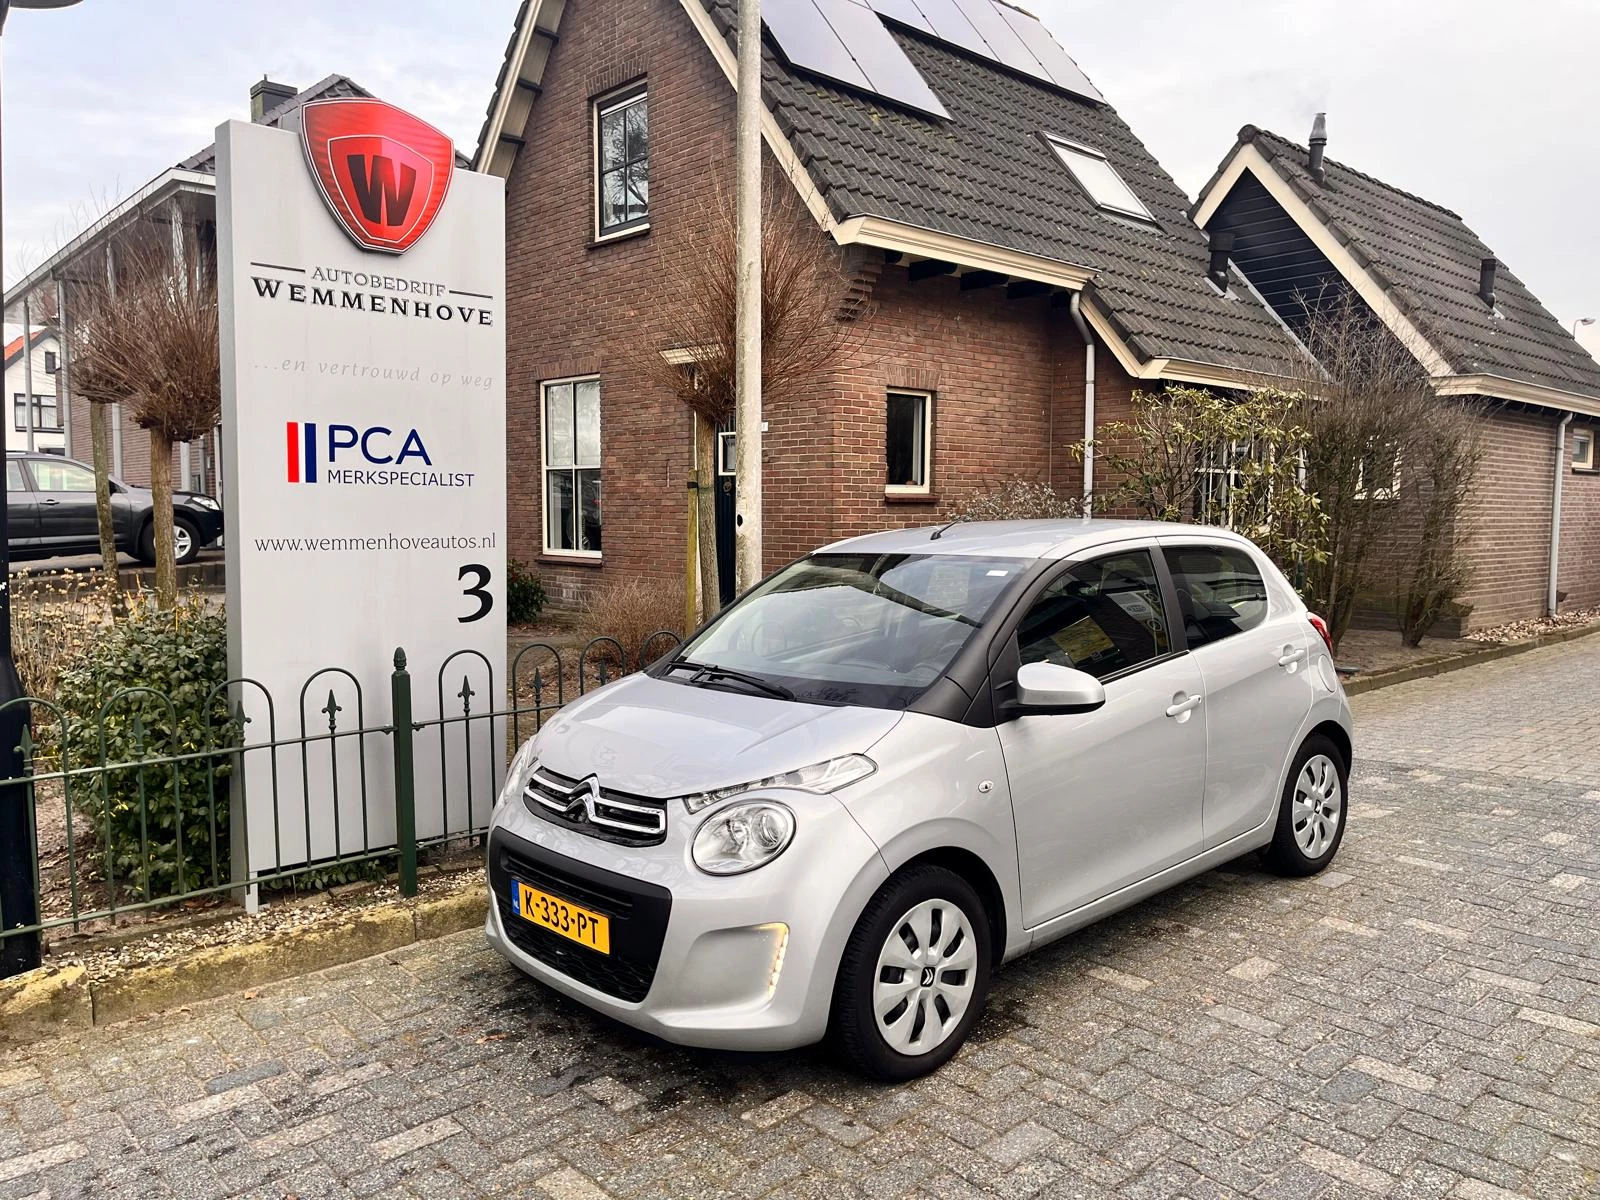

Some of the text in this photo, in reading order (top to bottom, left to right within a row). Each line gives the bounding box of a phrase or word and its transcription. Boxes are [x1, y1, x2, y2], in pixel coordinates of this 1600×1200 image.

[346, 154, 417, 227] W
[250, 276, 493, 327] WEMMENHOVE
[311, 266, 446, 297] AUTOBEDRIJF
[319, 361, 421, 382] vertrouwd
[430, 371, 451, 386] op
[461, 374, 493, 391] weg
[328, 424, 432, 466] PCA
[327, 469, 475, 487] MERKSPECIALIST
[254, 532, 496, 552] www.wemmenhoveautos.nl
[457, 563, 494, 623] 3
[525, 889, 599, 945] K-333-PT
